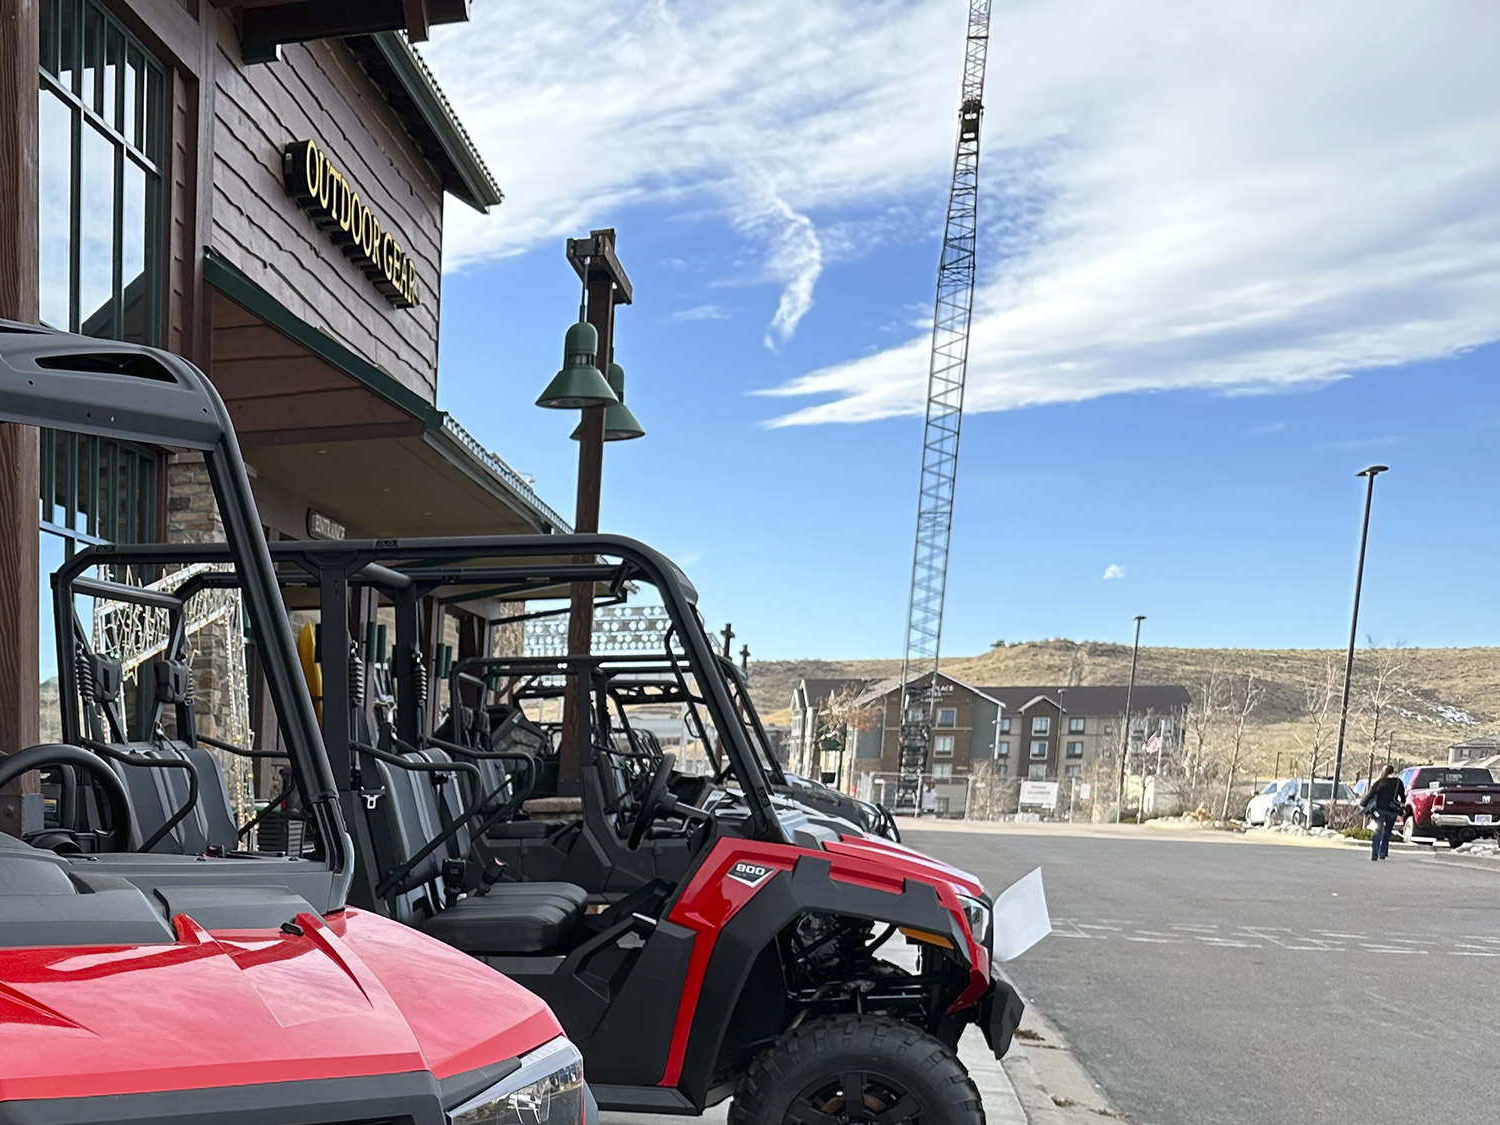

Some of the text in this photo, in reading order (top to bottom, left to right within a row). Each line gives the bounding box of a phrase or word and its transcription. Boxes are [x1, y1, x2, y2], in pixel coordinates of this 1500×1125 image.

[306, 139, 418, 304] OUTDOOR GEAR
[315, 514, 346, 541] ENTRANCE
[736, 863, 765, 876] 800
